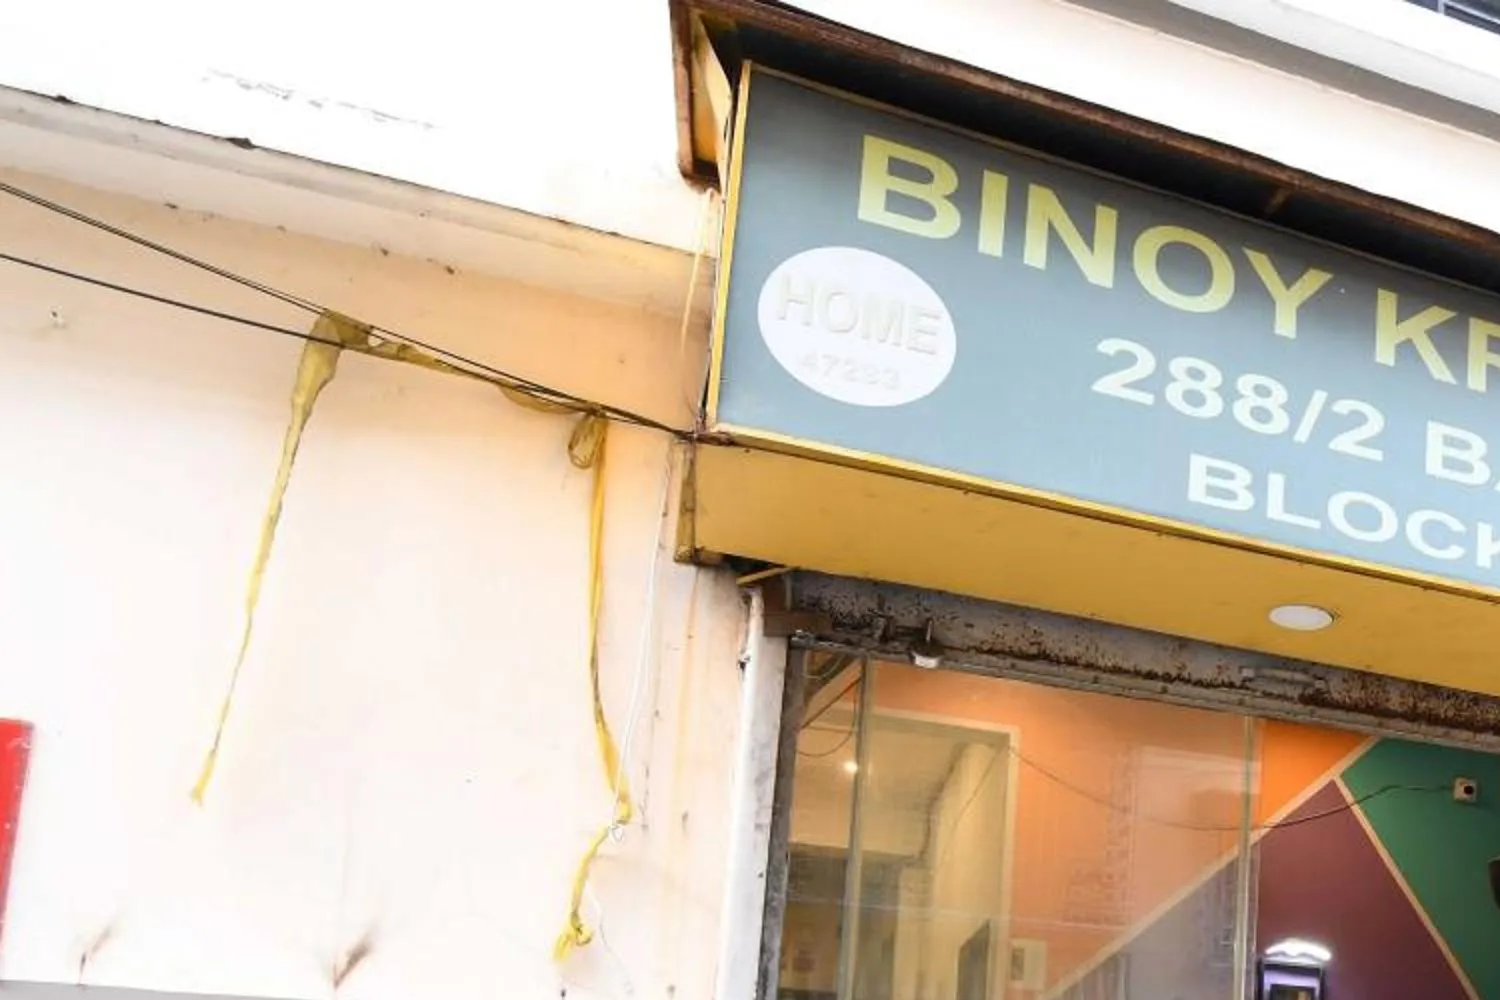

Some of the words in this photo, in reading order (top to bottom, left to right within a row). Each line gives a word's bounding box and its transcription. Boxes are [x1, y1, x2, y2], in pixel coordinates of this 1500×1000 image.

[856, 134, 1333, 340] BINOY
[775, 270, 943, 355] HOME
[1091, 338, 1386, 462] 288/2
